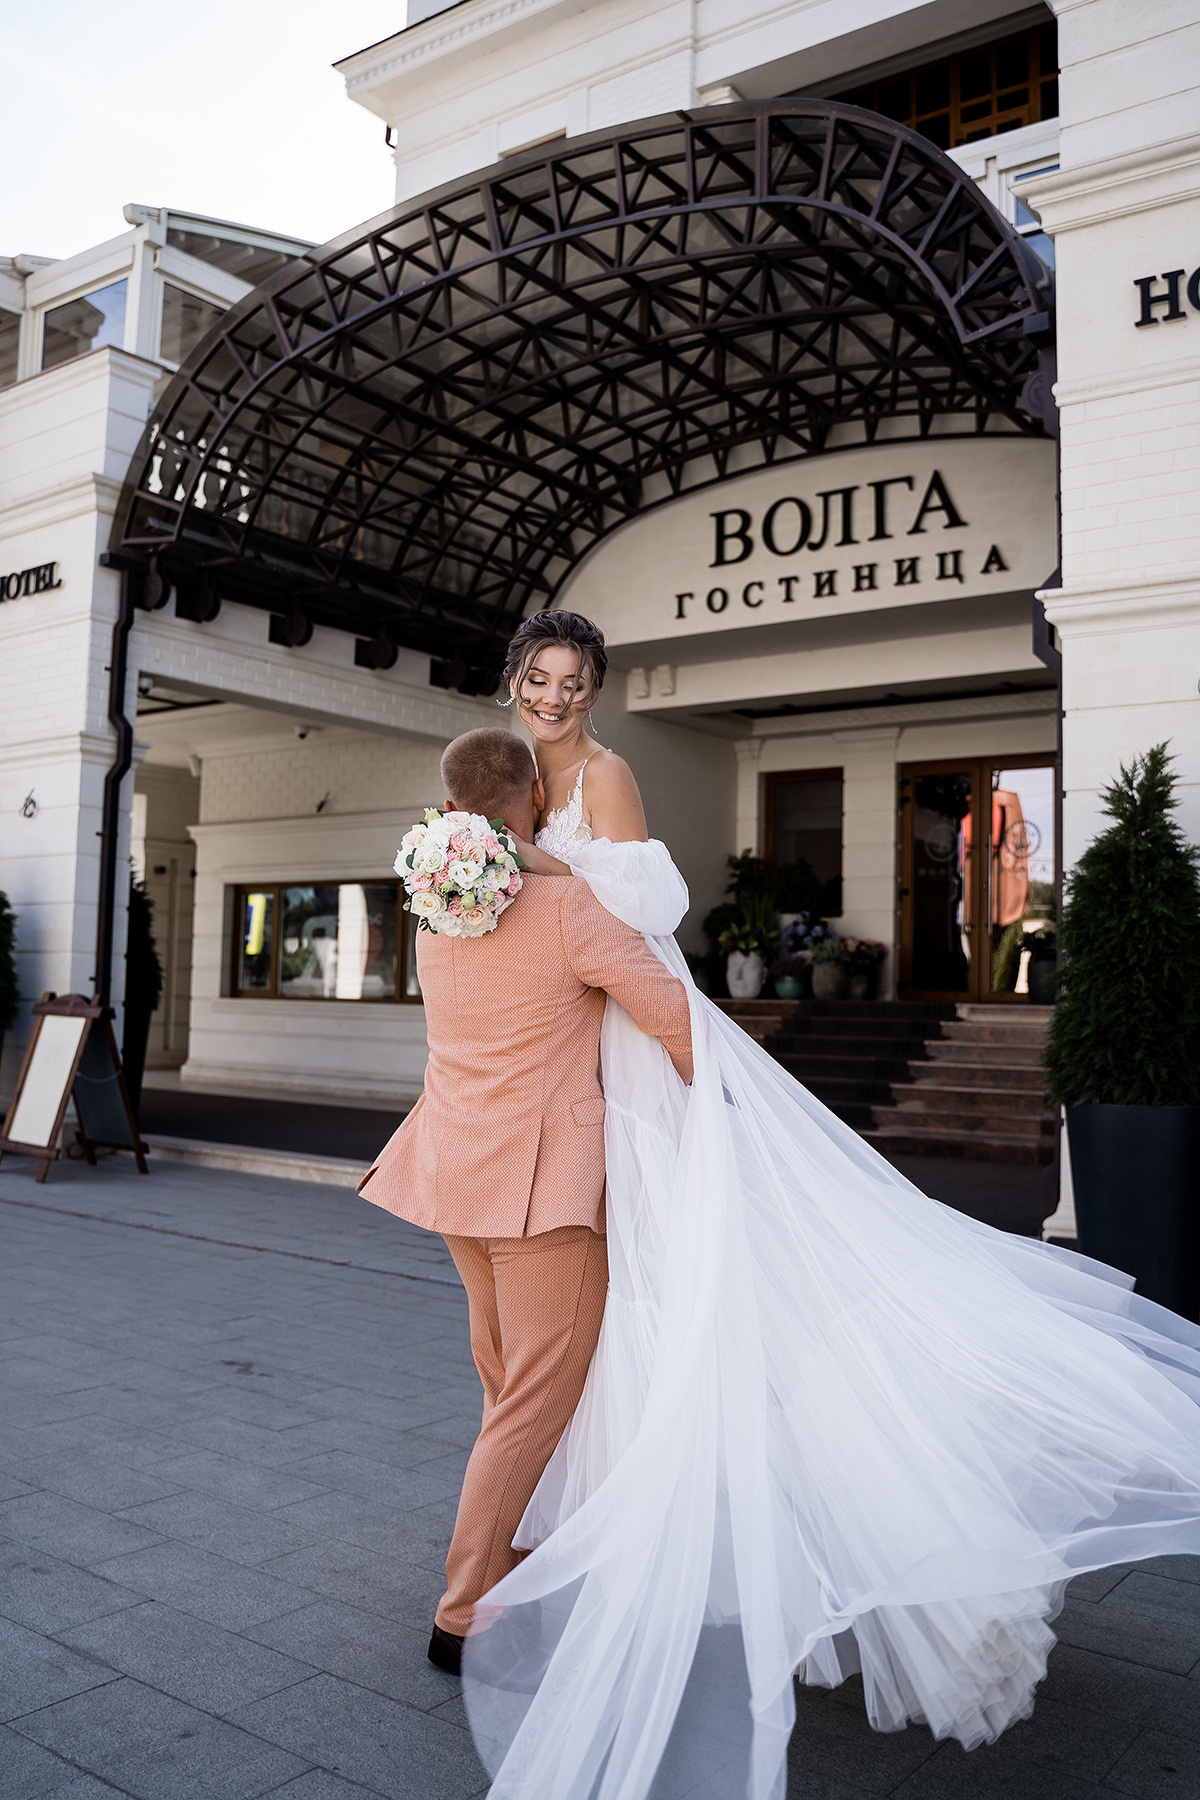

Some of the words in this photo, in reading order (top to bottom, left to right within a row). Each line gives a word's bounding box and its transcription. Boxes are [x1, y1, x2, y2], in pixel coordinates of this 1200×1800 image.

[1133, 267, 1200, 328] H
[708, 469, 969, 569] ВОЛГА
[674, 544, 1010, 620] ГОСТИНИЦА
